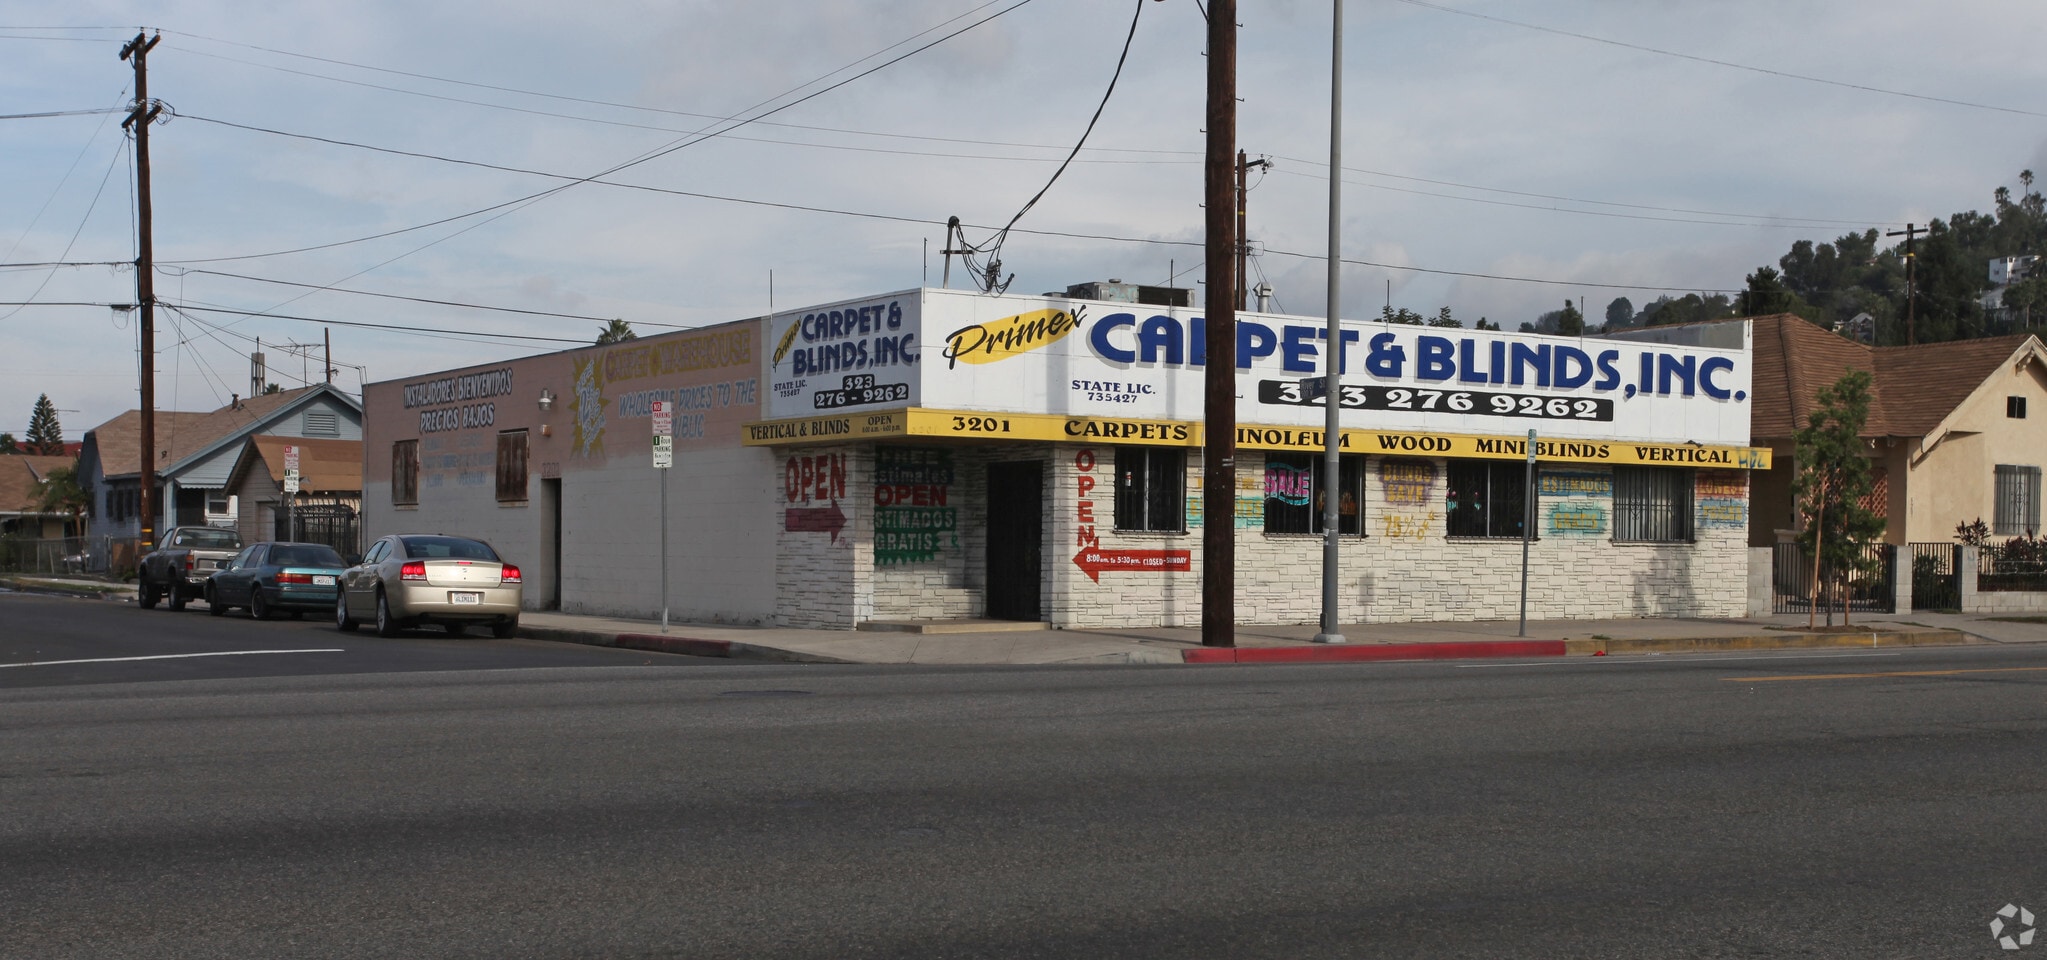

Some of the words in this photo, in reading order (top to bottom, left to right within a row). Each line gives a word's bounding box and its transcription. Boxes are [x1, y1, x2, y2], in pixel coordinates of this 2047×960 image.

[801, 304, 885, 341] CARPET
[887, 301, 902, 330] &
[943, 304, 1086, 370] Primex
[605, 347, 649, 382] CARPET
[659, 331, 751, 372] WAREHOUSE
[1365, 332, 1406, 378] &
[404, 377, 456, 409] INSTALADORES
[457, 367, 513, 401] BIENVENIDOS
[774, 381, 794, 392] STATE
[795, 379, 807, 389] LIC.
[845, 375, 873, 390] 323
[1071, 380, 1122, 394] STATE
[1126, 382, 1156, 395] LIC.
[678, 384, 712, 411] PRICES
[717, 382, 731, 406] TO
[735, 378, 756, 405] THE
[816, 392, 845, 406] 276
[863, 385, 906, 402] 9262
[1087, 391, 1137, 404] 735427
[1278, 383, 1367, 406] 33
[1386, 391, 1474, 412] 276
[1490, 396, 1598, 418] 9262
[654, 403, 661, 411] NO
[419, 406, 459, 434] PRECIOS
[462, 402, 495, 428] BAJOS
[867, 415, 892, 425] OPEN
[951, 415, 1011, 433] 3201
[751, 423, 797, 440] VERTICAL
[799, 422, 807, 437] &
[811, 419, 849, 435] BLINDS
[1064, 420, 1188, 440] CARPETS
[1237, 429, 1350, 447] INOLEUM
[654, 445, 671, 453] PARKING
[1377, 435, 1452, 452] WOOD
[1476, 438, 1526, 454] MINI
[1536, 441, 1610, 458] BLINDS
[1635, 446, 1731, 464] VERTICAL
[786, 453, 847, 503] OPEN
[1383, 464, 1431, 482] BLINDS
[1264, 469, 1310, 496] SALE
[1542, 476, 1610, 493] ESTIMADOS
[874, 484, 947, 506] OPEN
[1387, 484, 1425, 502] SAVE
[875, 510, 953, 528] STIMADOS
[1383, 513, 1414, 537] 75%
[1553, 513, 1598, 529] GRATIS
[875, 532, 933, 550] GRATIS
